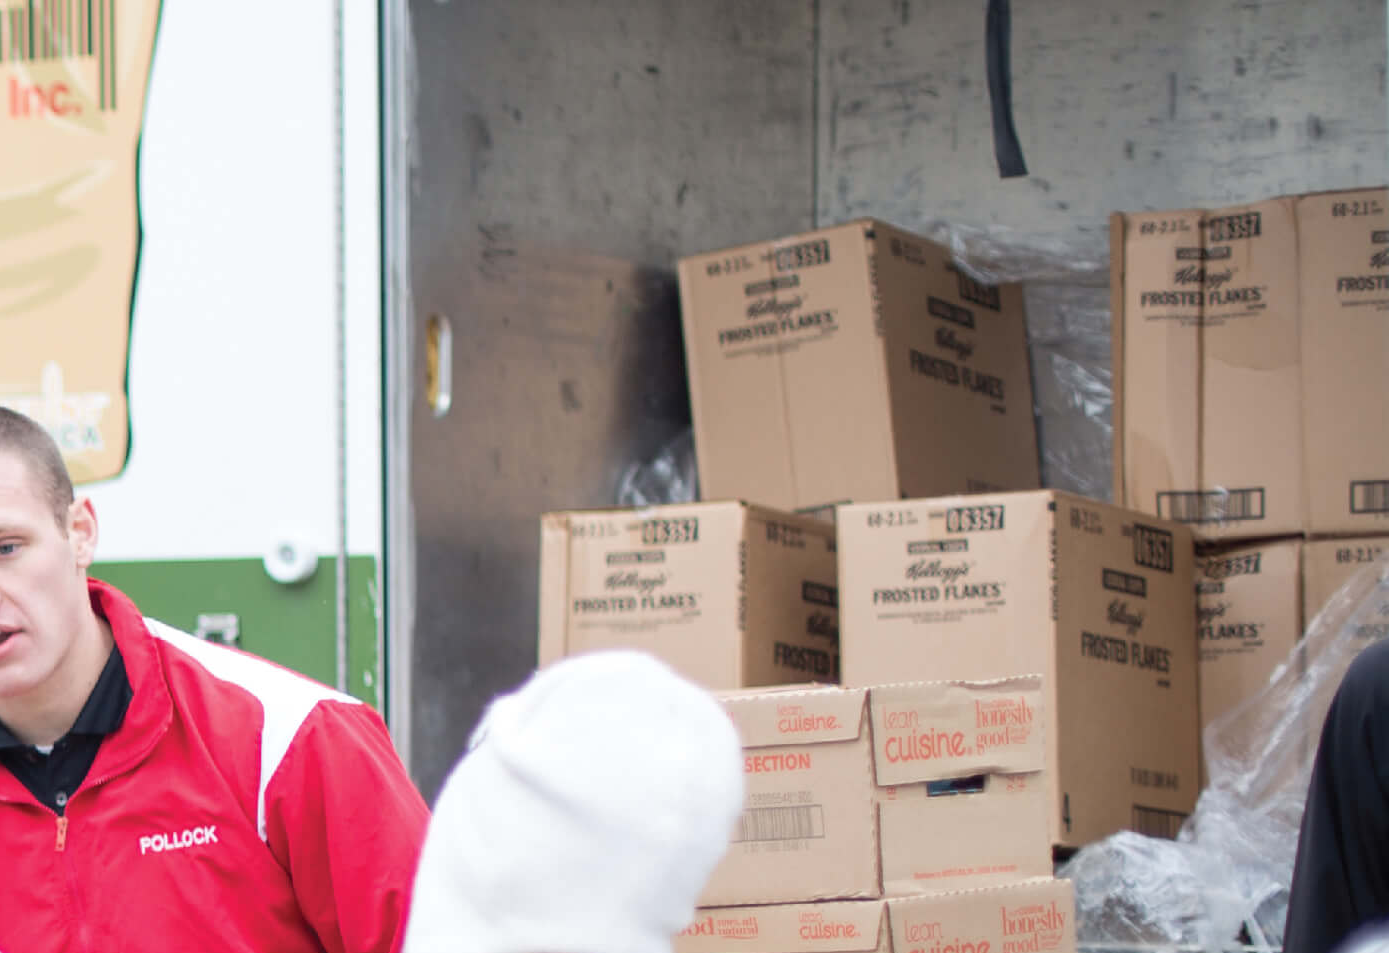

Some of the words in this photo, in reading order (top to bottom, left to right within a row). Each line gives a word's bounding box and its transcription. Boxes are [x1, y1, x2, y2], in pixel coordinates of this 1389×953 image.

[8, 74, 83, 117] Inc.
[946, 505, 1005, 533] 06357
[574, 598, 637, 614] FROSTED
[640, 594, 697, 610] FLAKES
[873, 586, 940, 605] FROSTED
[944, 582, 1002, 601] FLAKES
[882, 704, 920, 730] lean
[744, 753, 812, 774] SECTION
[139, 825, 218, 855] POLLOCK
[904, 919, 943, 943] lean
